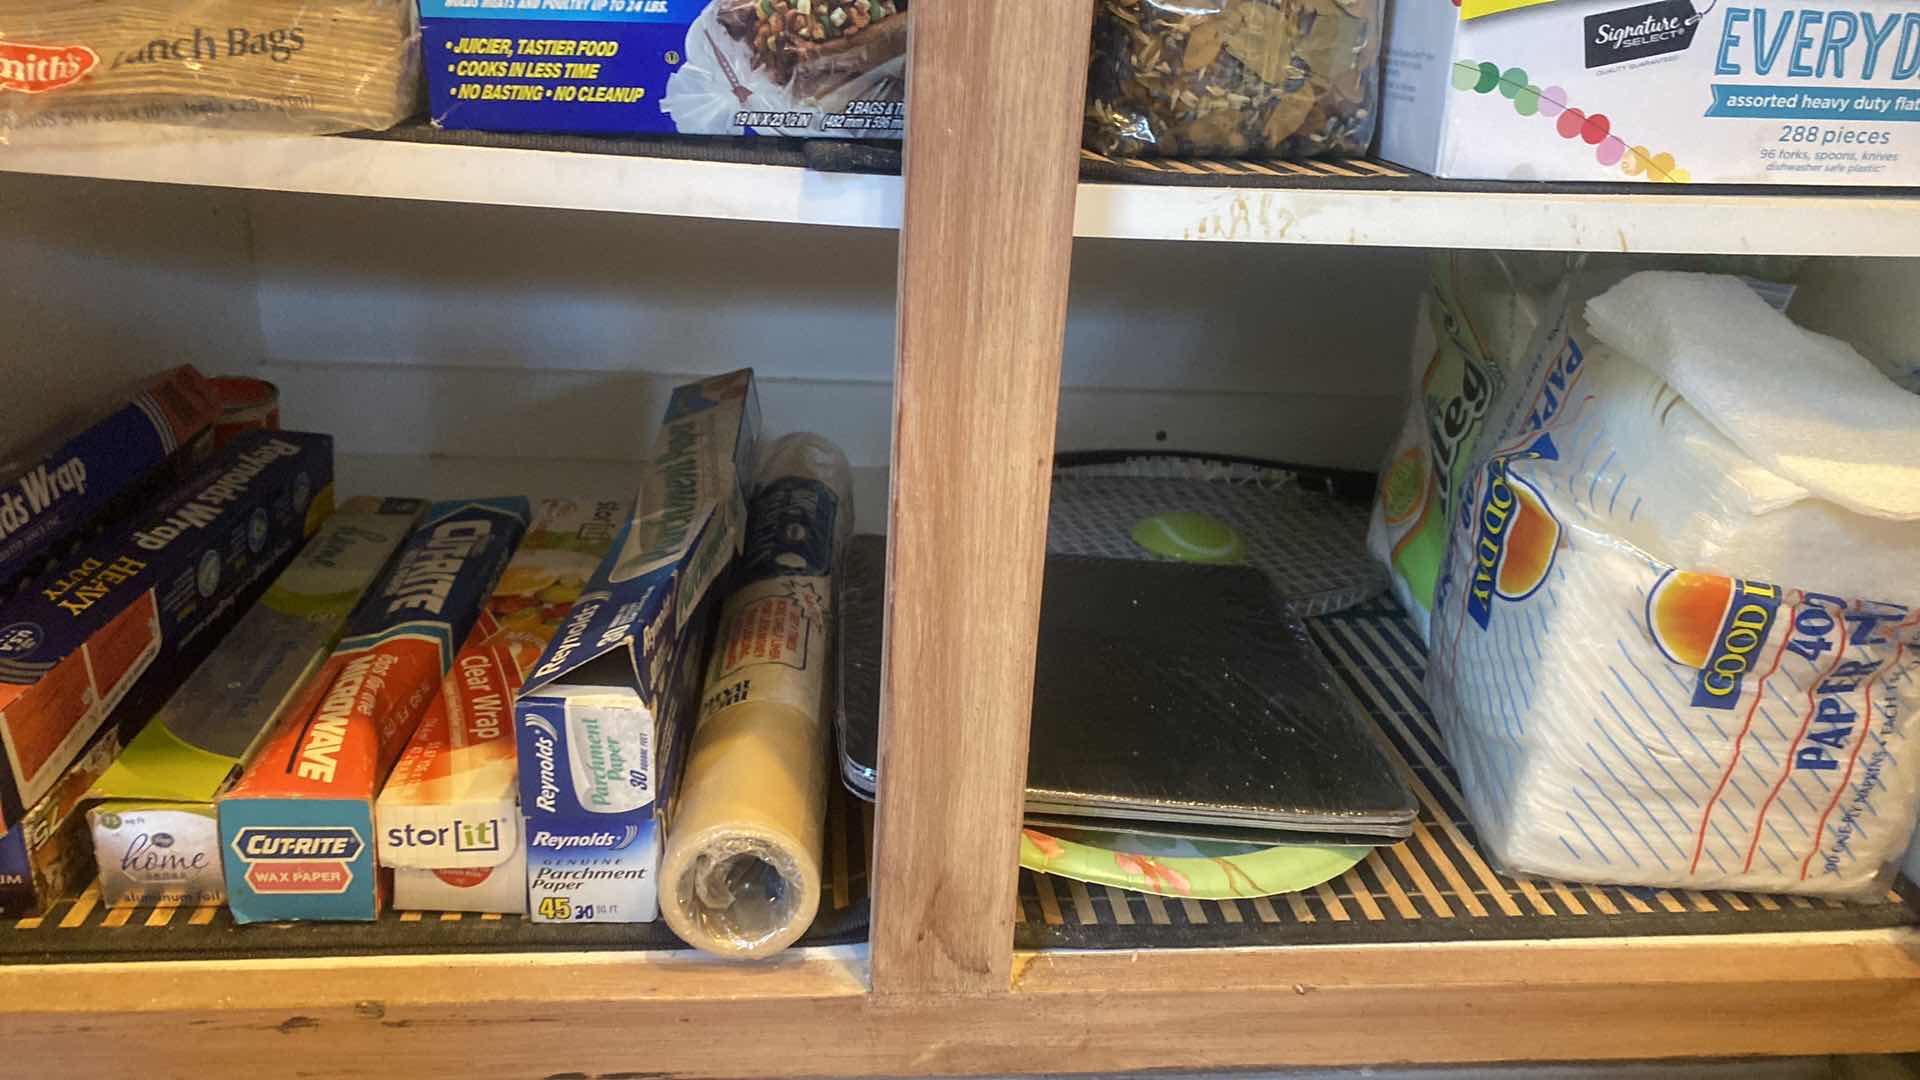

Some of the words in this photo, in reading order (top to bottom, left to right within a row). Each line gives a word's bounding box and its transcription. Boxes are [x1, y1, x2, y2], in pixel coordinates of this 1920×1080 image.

[227, 27, 305, 62] Bags
[1595, 15, 1681, 49] Signature
[1714, 7, 1920, 81] EVERYD
[453, 38, 513, 58] JUICIER,
[517, 39, 576, 56] TASTIER
[576, 41, 619, 57] FOOD
[0, 53, 81, 82] mith's
[456, 60, 508, 77] COOKS
[508, 62, 524, 78] IN
[524, 62, 563, 78] LESS
[563, 63, 601, 79] TIME
[458, 84, 481, 99] NO
[481, 84, 544, 101] BASTING
[554, 86, 578, 102] NO
[578, 86, 645, 103] CLEANUP
[855, 101, 887, 115] BAGS
[1727, 93, 1798, 109] assorted
[1801, 94, 1850, 112] heavy
[1853, 96, 1892, 113] duty
[1778, 124, 1819, 143] 288
[1821, 126, 1891, 146] pieces
[1760, 149, 1776, 160] 96
[1778, 149, 1810, 161] forks,
[1861, 151, 1899, 162] knives
[20, 457, 88, 515] Wrap
[130, 501, 226, 551] Wrap
[41, 556, 104, 602] DUTY
[57, 554, 147, 617] HEAVY
[534, 603, 600, 678] Reynolds
[1704, 604, 1769, 697] GOOD
[461, 654, 492, 693] Clear
[298, 652, 377, 784] MICROWAVE
[469, 693, 501, 740] Wrap
[1796, 659, 1884, 770] PAPER
[536, 736, 556, 813] Reynolds
[582, 717, 610, 807] Parchment
[607, 736, 626, 782] Paper
[629, 769, 649, 791] 30
[1853, 750, 1887, 804] NAPKINS
[121, 832, 209, 871] home
[247, 834, 350, 856] CUT-RITE
[532, 831, 616, 850] Reynolds
[254, 871, 289, 884] WAX
[292, 870, 341, 883] PAPER
[537, 867, 648, 880] Parchment
[543, 858, 624, 866] GENUINE
[195, 888, 221, 902] foil
[532, 879, 585, 893] Paper
[538, 896, 572, 920] 45
